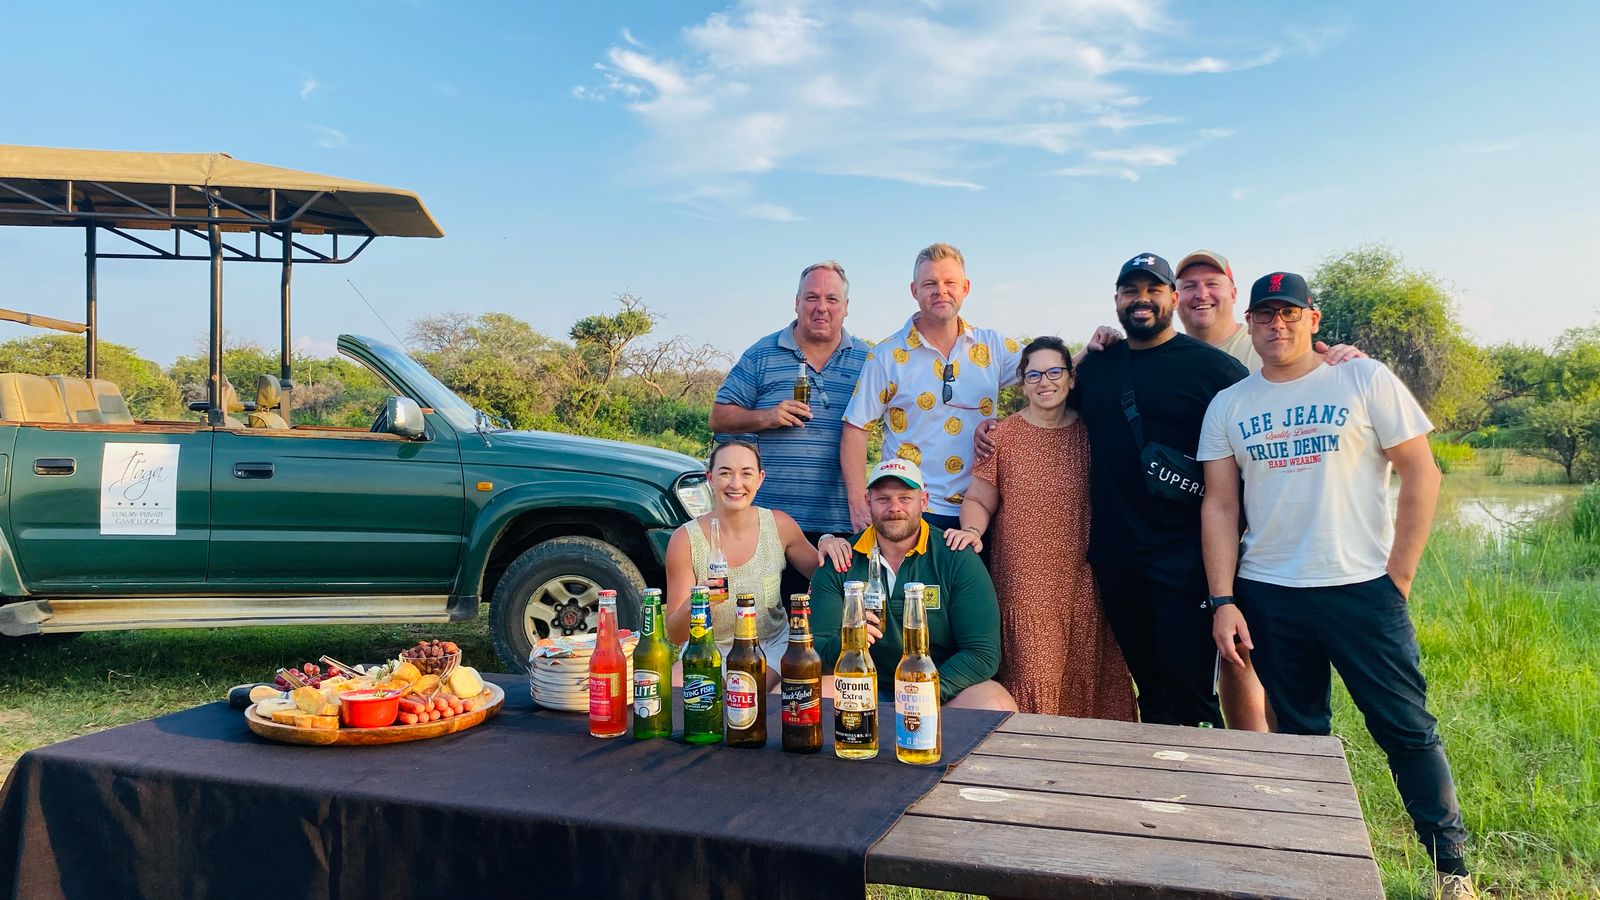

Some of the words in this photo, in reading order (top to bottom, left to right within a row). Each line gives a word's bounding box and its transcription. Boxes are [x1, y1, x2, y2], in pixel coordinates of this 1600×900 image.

[1238, 412, 1273, 440] LEE
[1282, 404, 1350, 428] JEANS
[1265, 430, 1291, 441] Quality
[1292, 427, 1318, 437] Denim
[1246, 441, 1290, 461] TRUE
[1293, 434, 1340, 457] DENIM
[880, 463, 906, 471] CASTLE
[1268, 460, 1288, 469] HARD
[1289, 454, 1322, 467] WEARING
[635, 685, 657, 697] LITE
[700, 684, 714, 694] FISH
[835, 678, 871, 693] Corona
[727, 694, 753, 704] CASTLE
[842, 691, 863, 700] Extra
